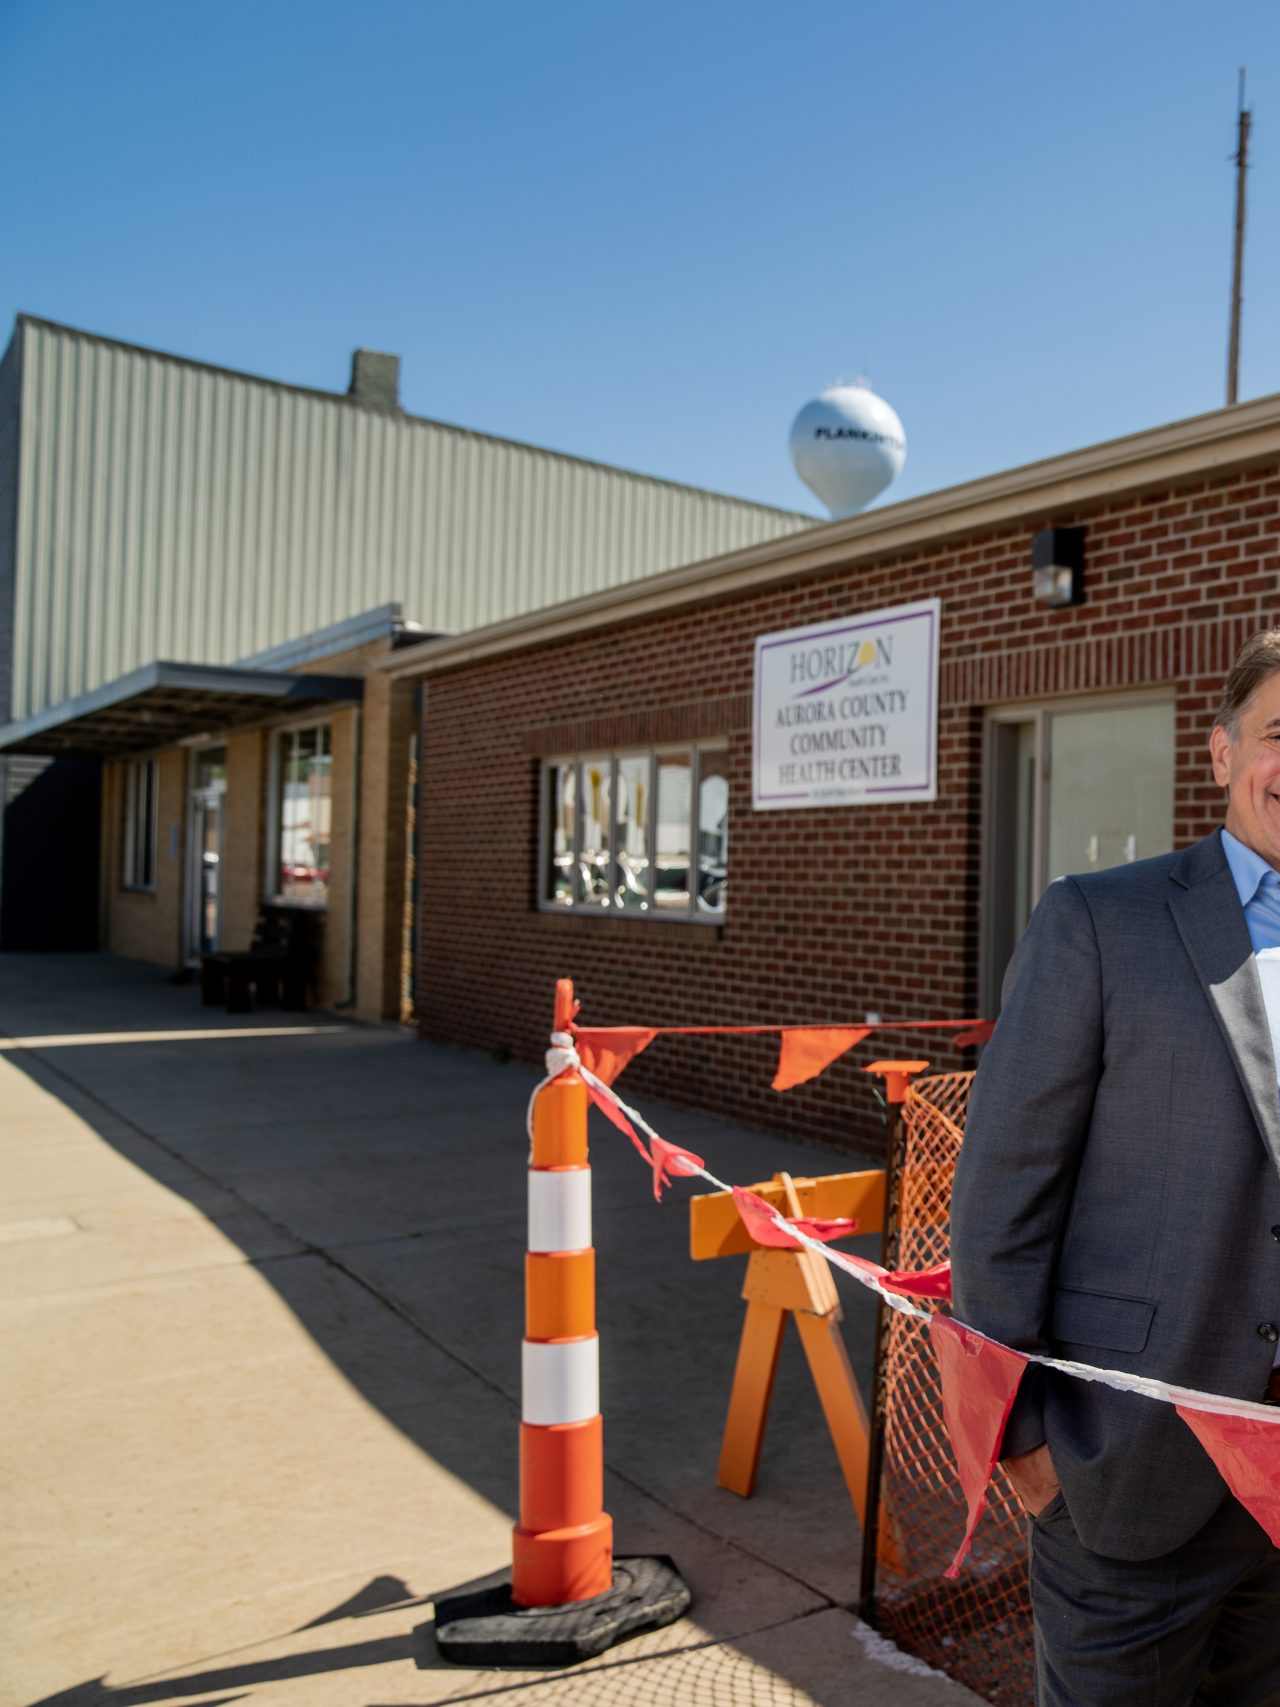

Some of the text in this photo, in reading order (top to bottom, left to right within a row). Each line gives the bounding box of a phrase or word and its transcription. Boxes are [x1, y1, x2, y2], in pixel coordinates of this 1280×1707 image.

[815, 427, 904, 449] PLANKIN
[776, 688, 910, 728] AURORA COUNTY
[791, 723, 888, 755] COMMUNITY
[778, 753, 901, 785] HEALTH CENTER
